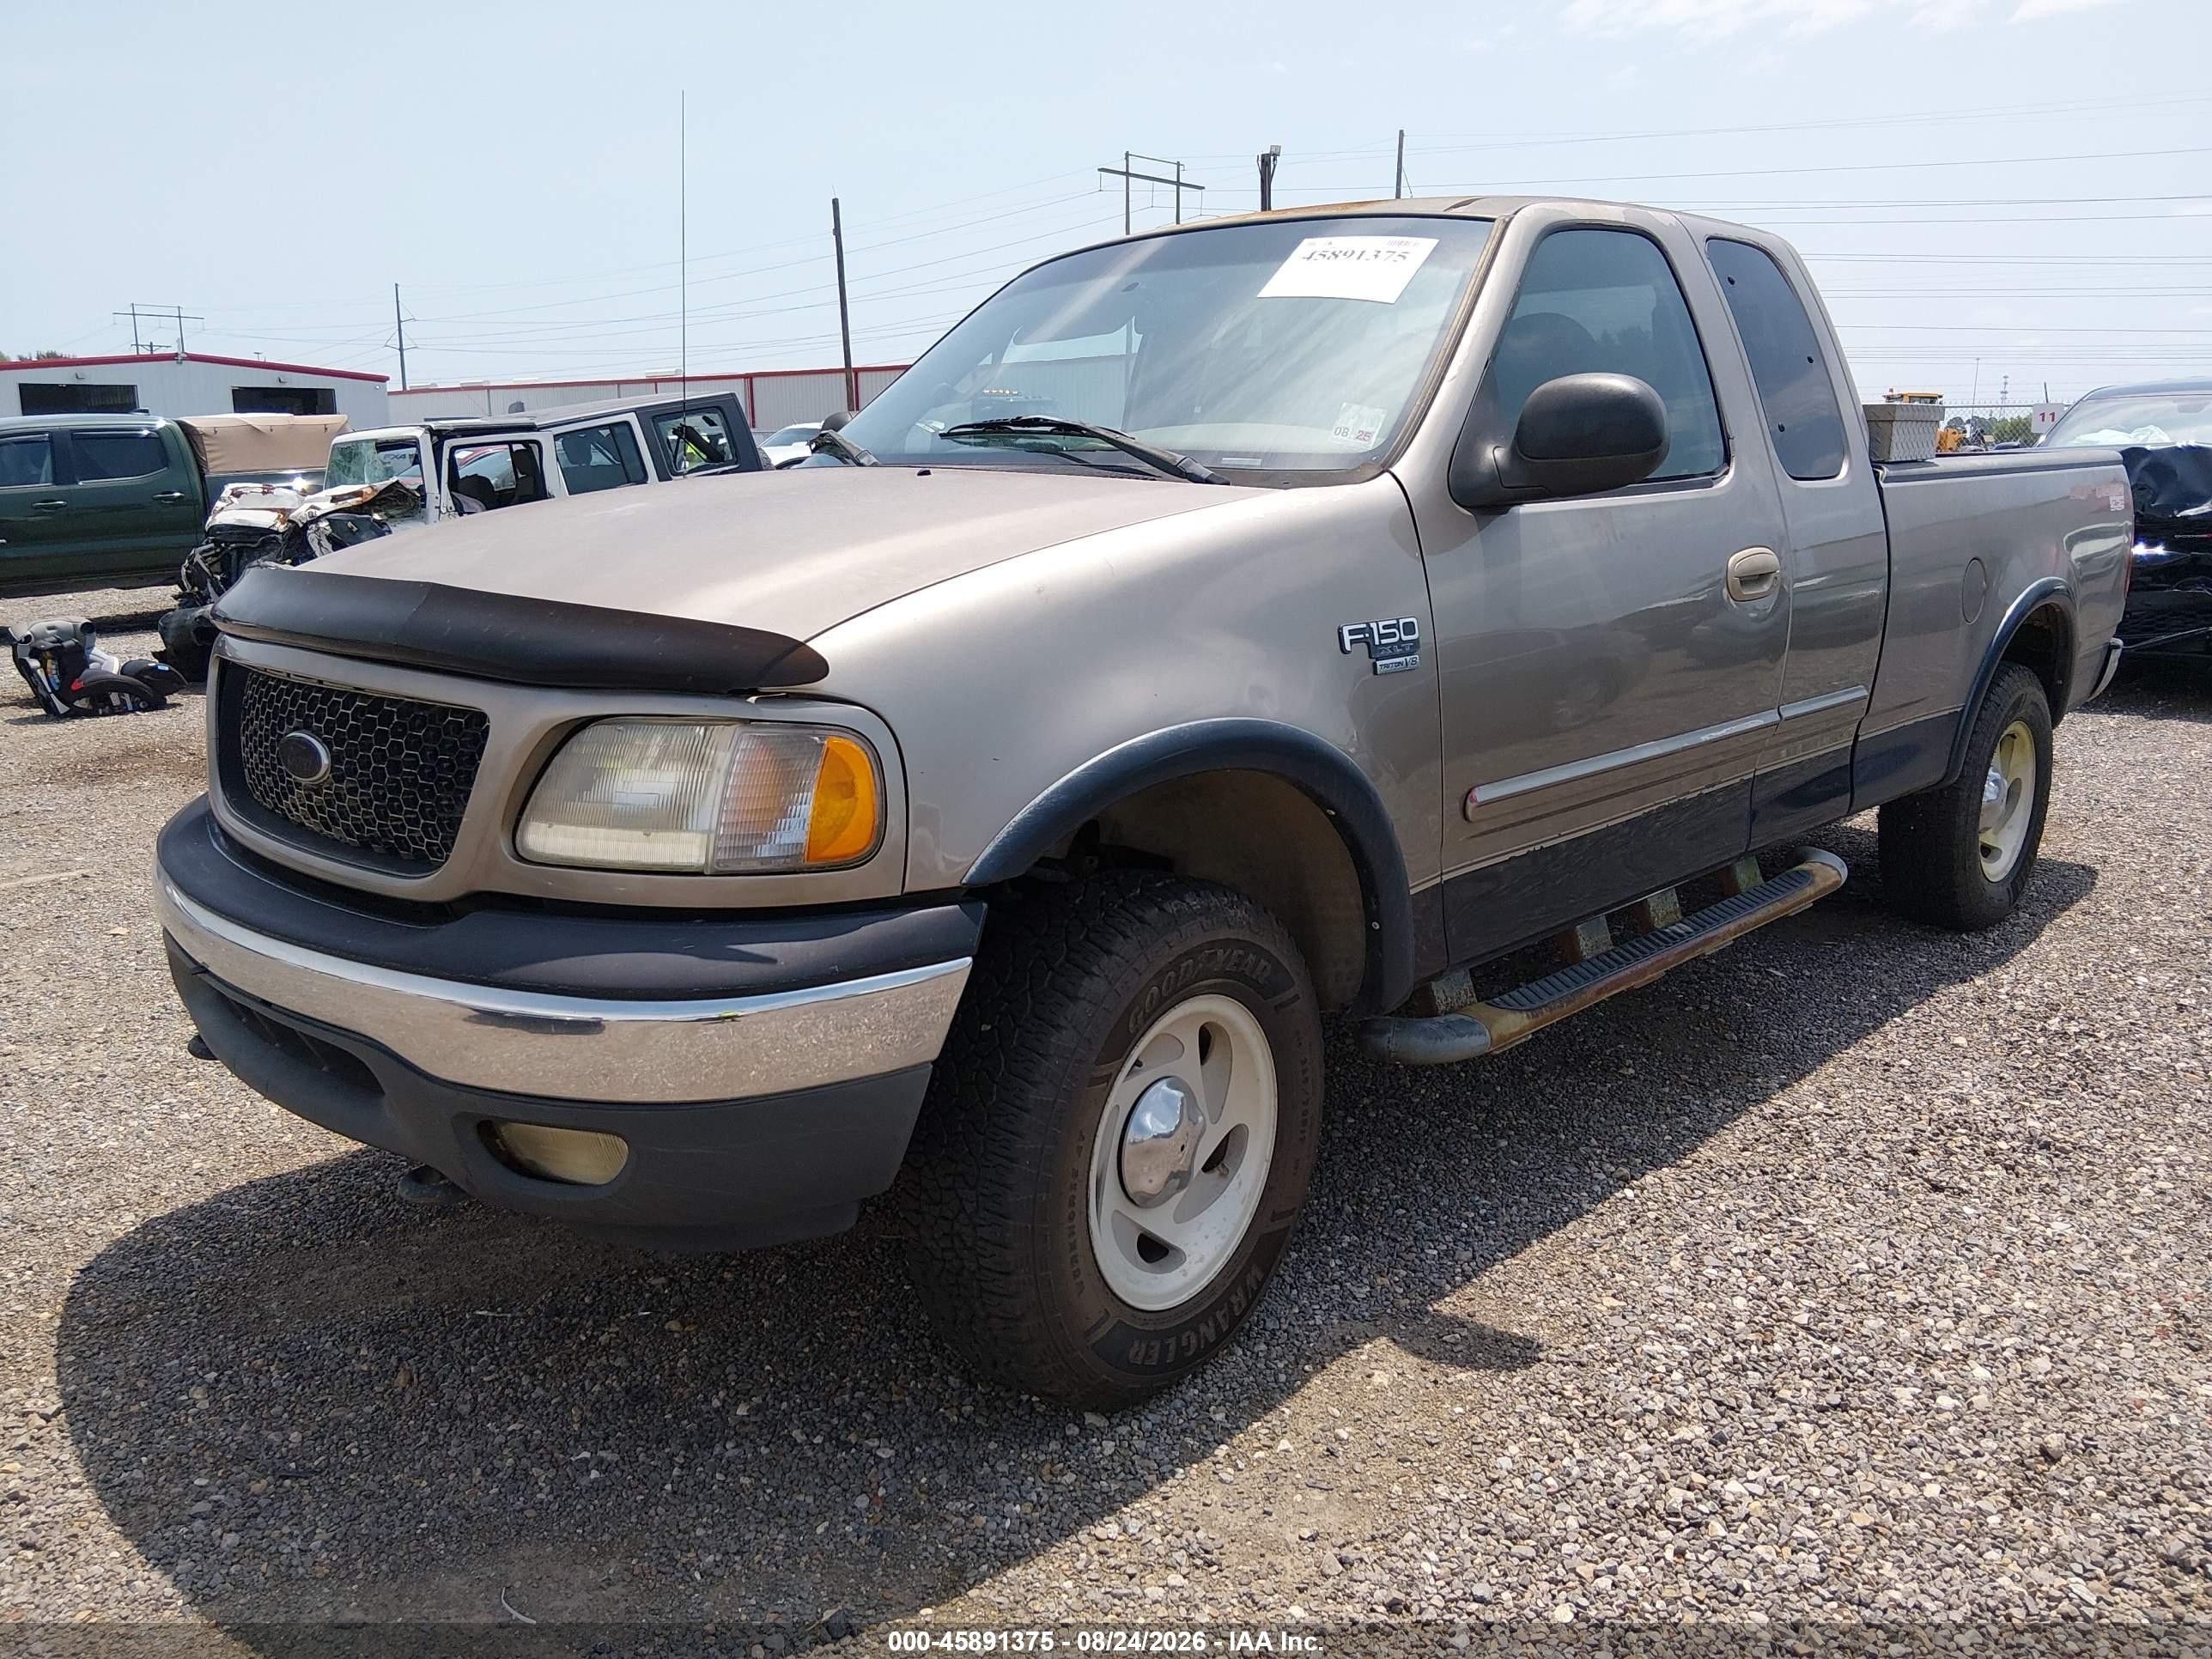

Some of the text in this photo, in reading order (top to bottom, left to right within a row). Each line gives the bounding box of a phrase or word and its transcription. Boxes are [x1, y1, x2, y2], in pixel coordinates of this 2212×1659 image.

[1301, 249, 1410, 263] 45891375
[2039, 411, 2056, 422] 11
[1334, 426, 1372, 441] 08 25
[1379, 642, 1414, 654] XLT
[1378, 657, 1419, 671] TRITON V8
[1128, 948, 1272, 1034] GOODYEAR
[1127, 1263, 1266, 1366] WRANGLER
